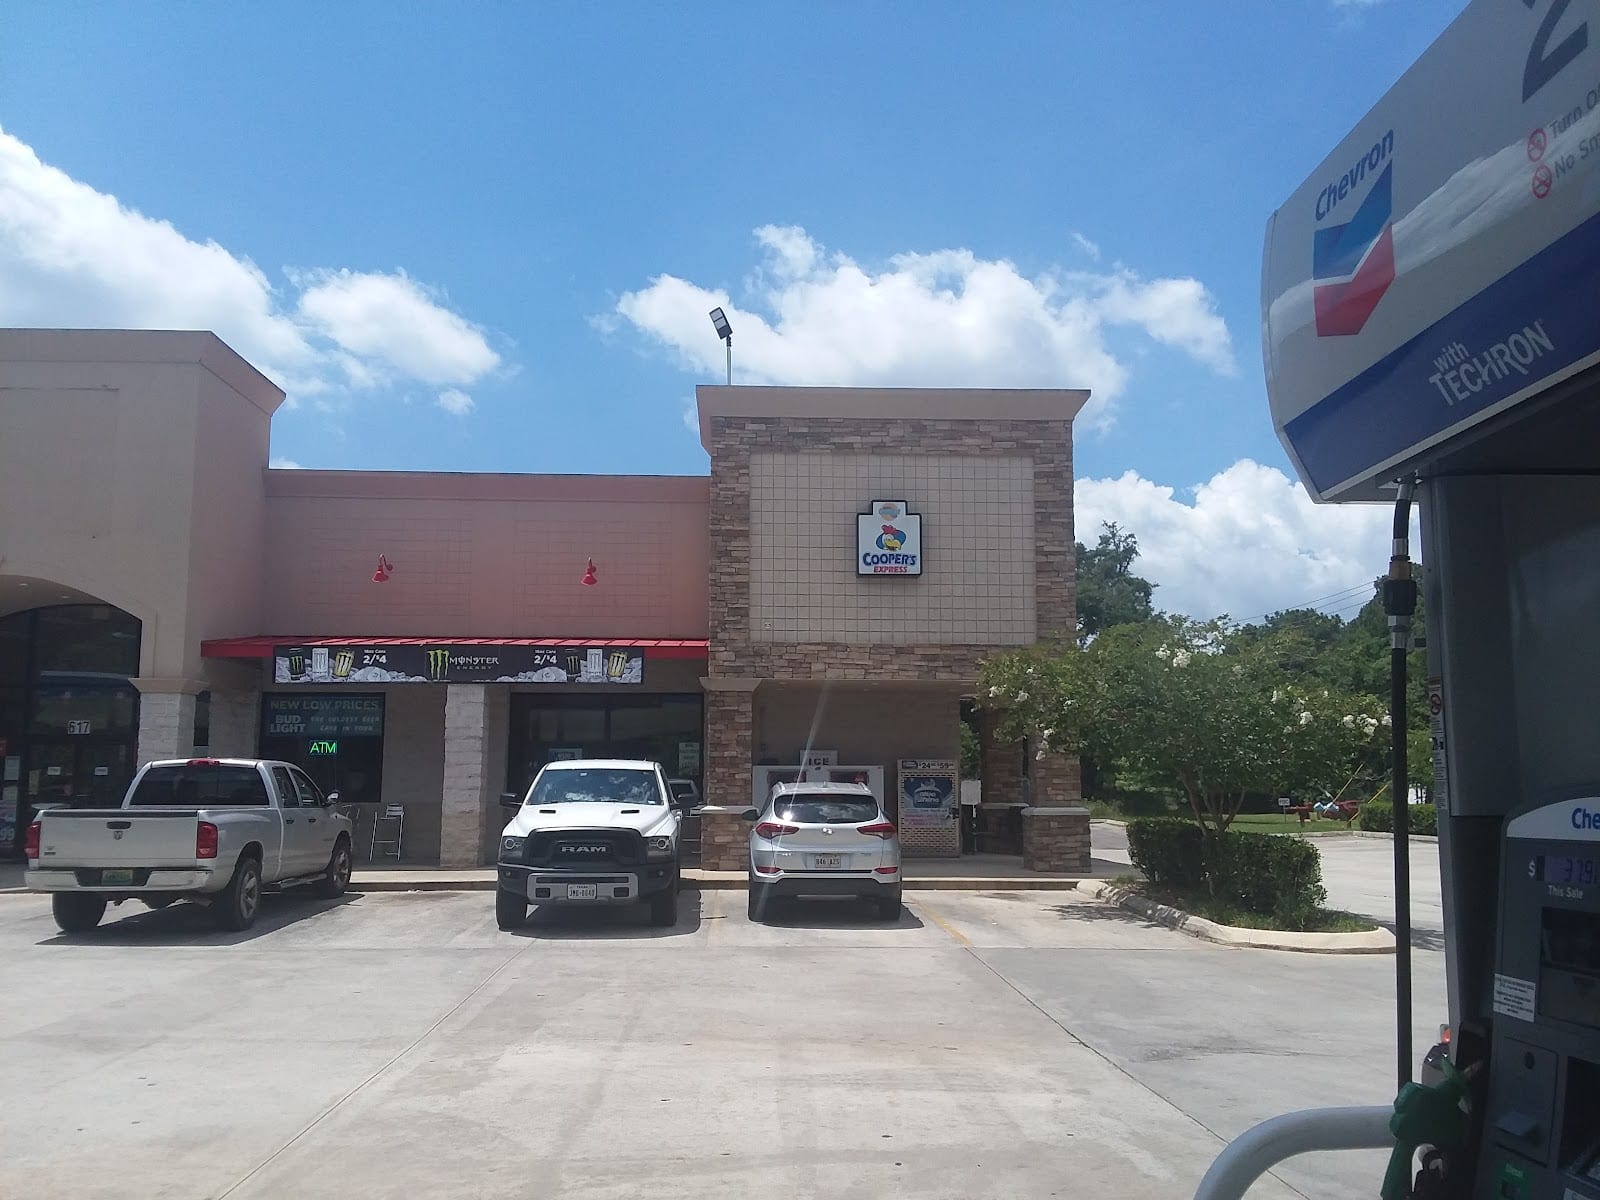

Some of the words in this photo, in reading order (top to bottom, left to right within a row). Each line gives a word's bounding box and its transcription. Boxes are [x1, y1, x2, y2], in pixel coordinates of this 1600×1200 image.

[1549, 105, 1582, 139] Turn
[1554, 154, 1575, 179] No
[1315, 128, 1394, 221] Chevron
[1428, 320, 1555, 406] TECHRON
[1432, 341, 1470, 373] with
[862, 552, 916, 566] COOPER'S
[449, 656, 500, 665] MONSTER
[270, 700, 299, 710] NEW
[303, 700, 332, 710] LOW
[334, 700, 379, 710] PRICES
[275, 714, 302, 724] BUD
[69, 720, 90, 734] 617
[270, 723, 306, 733] LIGHT
[310, 742, 336, 754] ATM
[808, 757, 829, 766] ICE
[1571, 807, 1600, 830] Che
[1547, 884, 1564, 896] This
[1566, 886, 1584, 899] Sale
